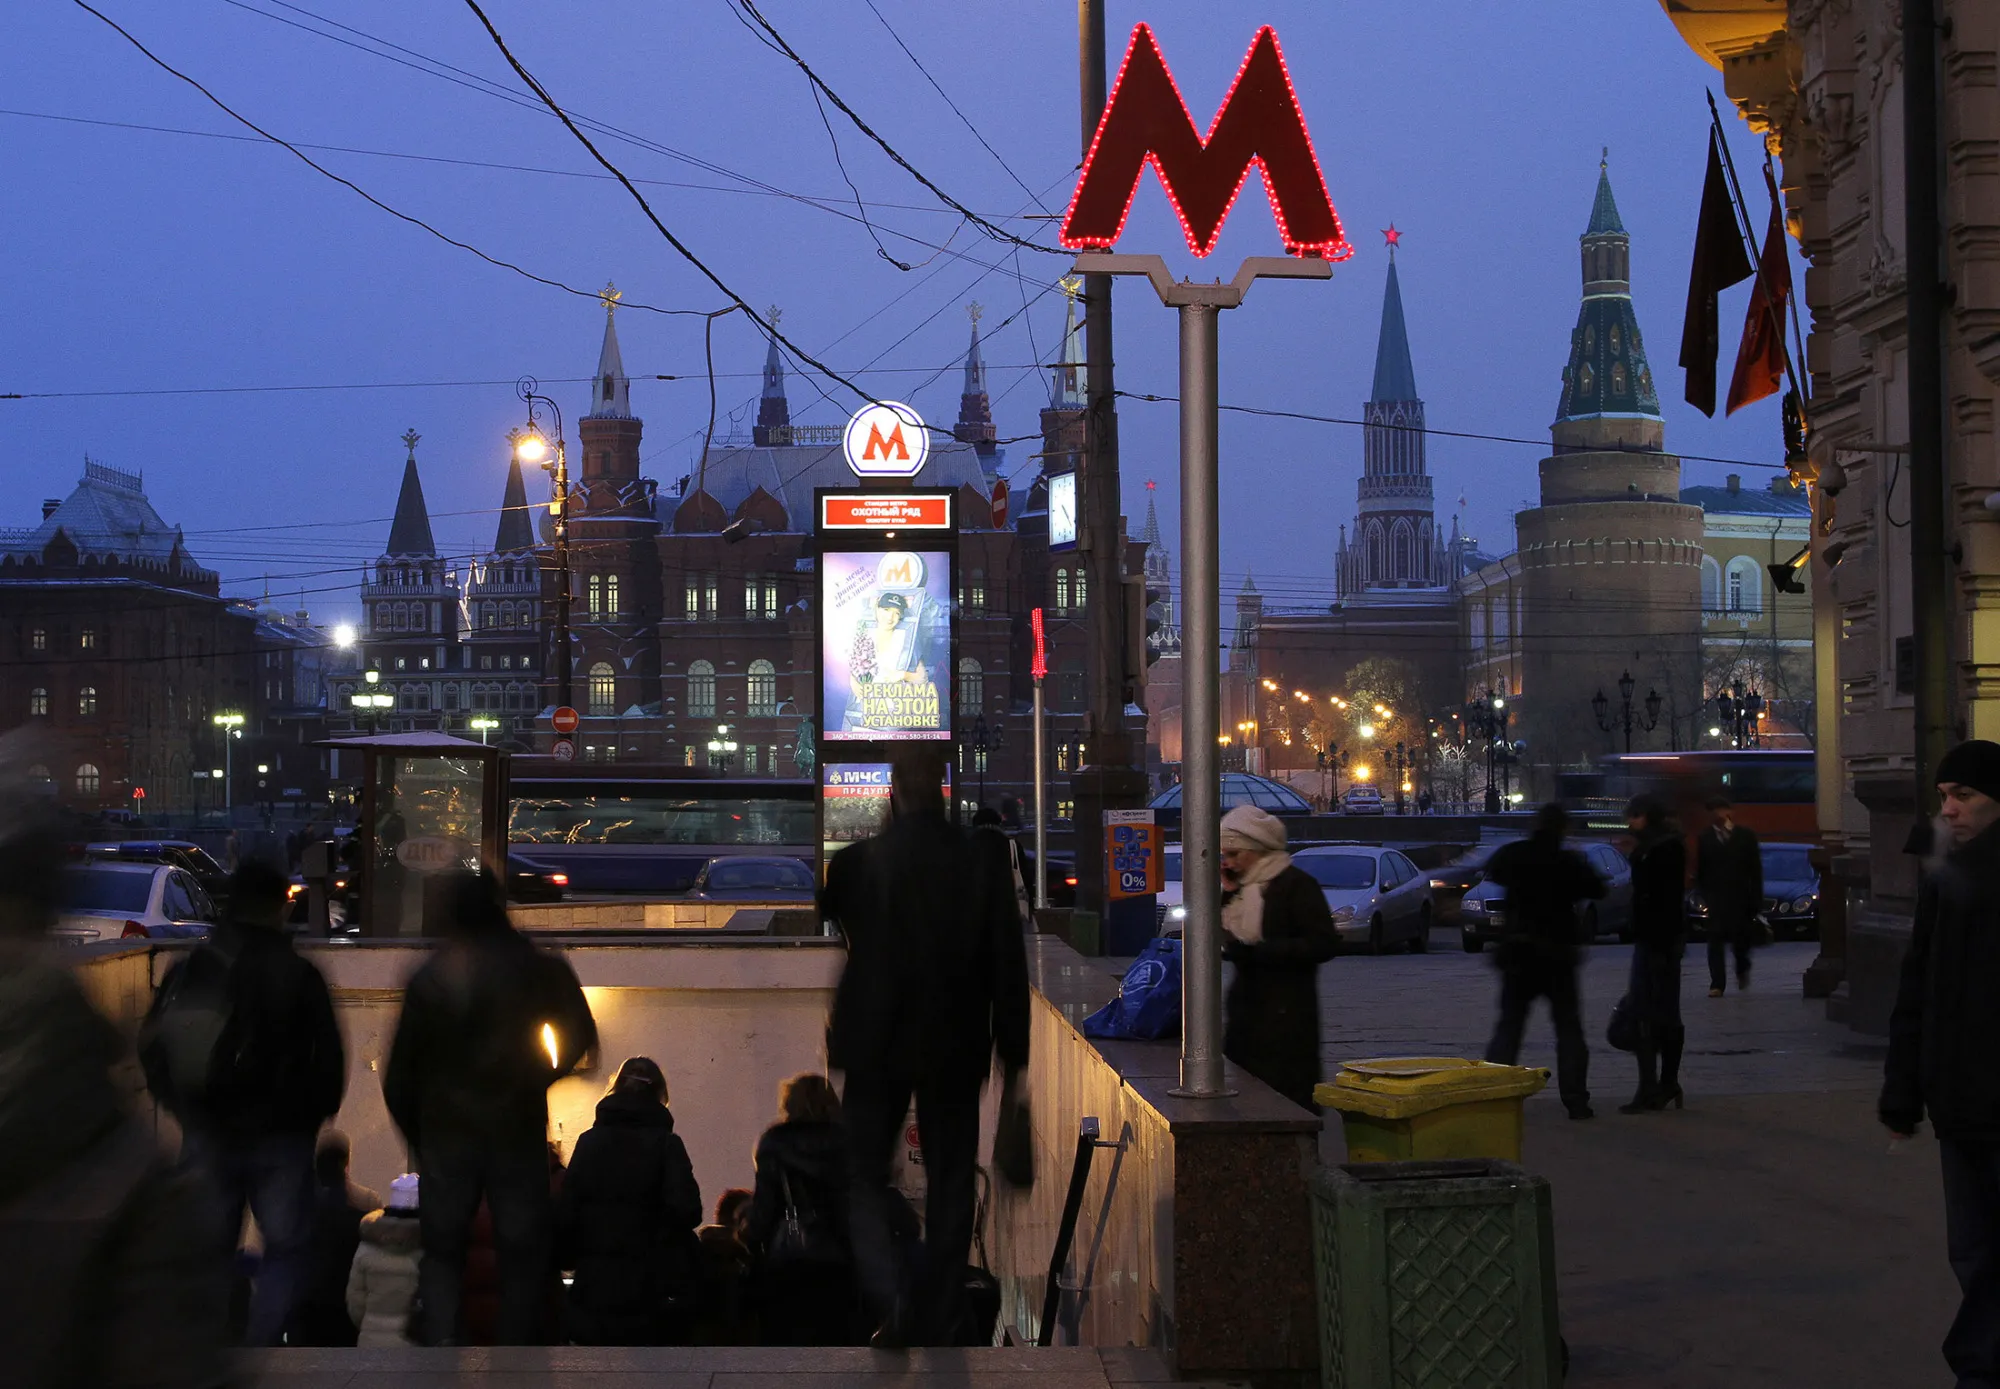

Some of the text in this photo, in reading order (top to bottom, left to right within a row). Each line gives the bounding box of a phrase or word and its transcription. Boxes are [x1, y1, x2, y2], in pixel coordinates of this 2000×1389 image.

[1058, 21, 1346, 260] М
[862, 421, 910, 462] М
[851, 506, 921, 518] ОХОТНЫЙ РЯД
[863, 683, 937, 698] РЕКЛАМА
[863, 698, 888, 715] НА
[863, 715, 939, 727] УСТАНОВКЕ
[844, 771, 882, 783] МЧС
[843, 787, 892, 796] ПРЕДУПР
[1122, 873, 1145, 887] 0%
